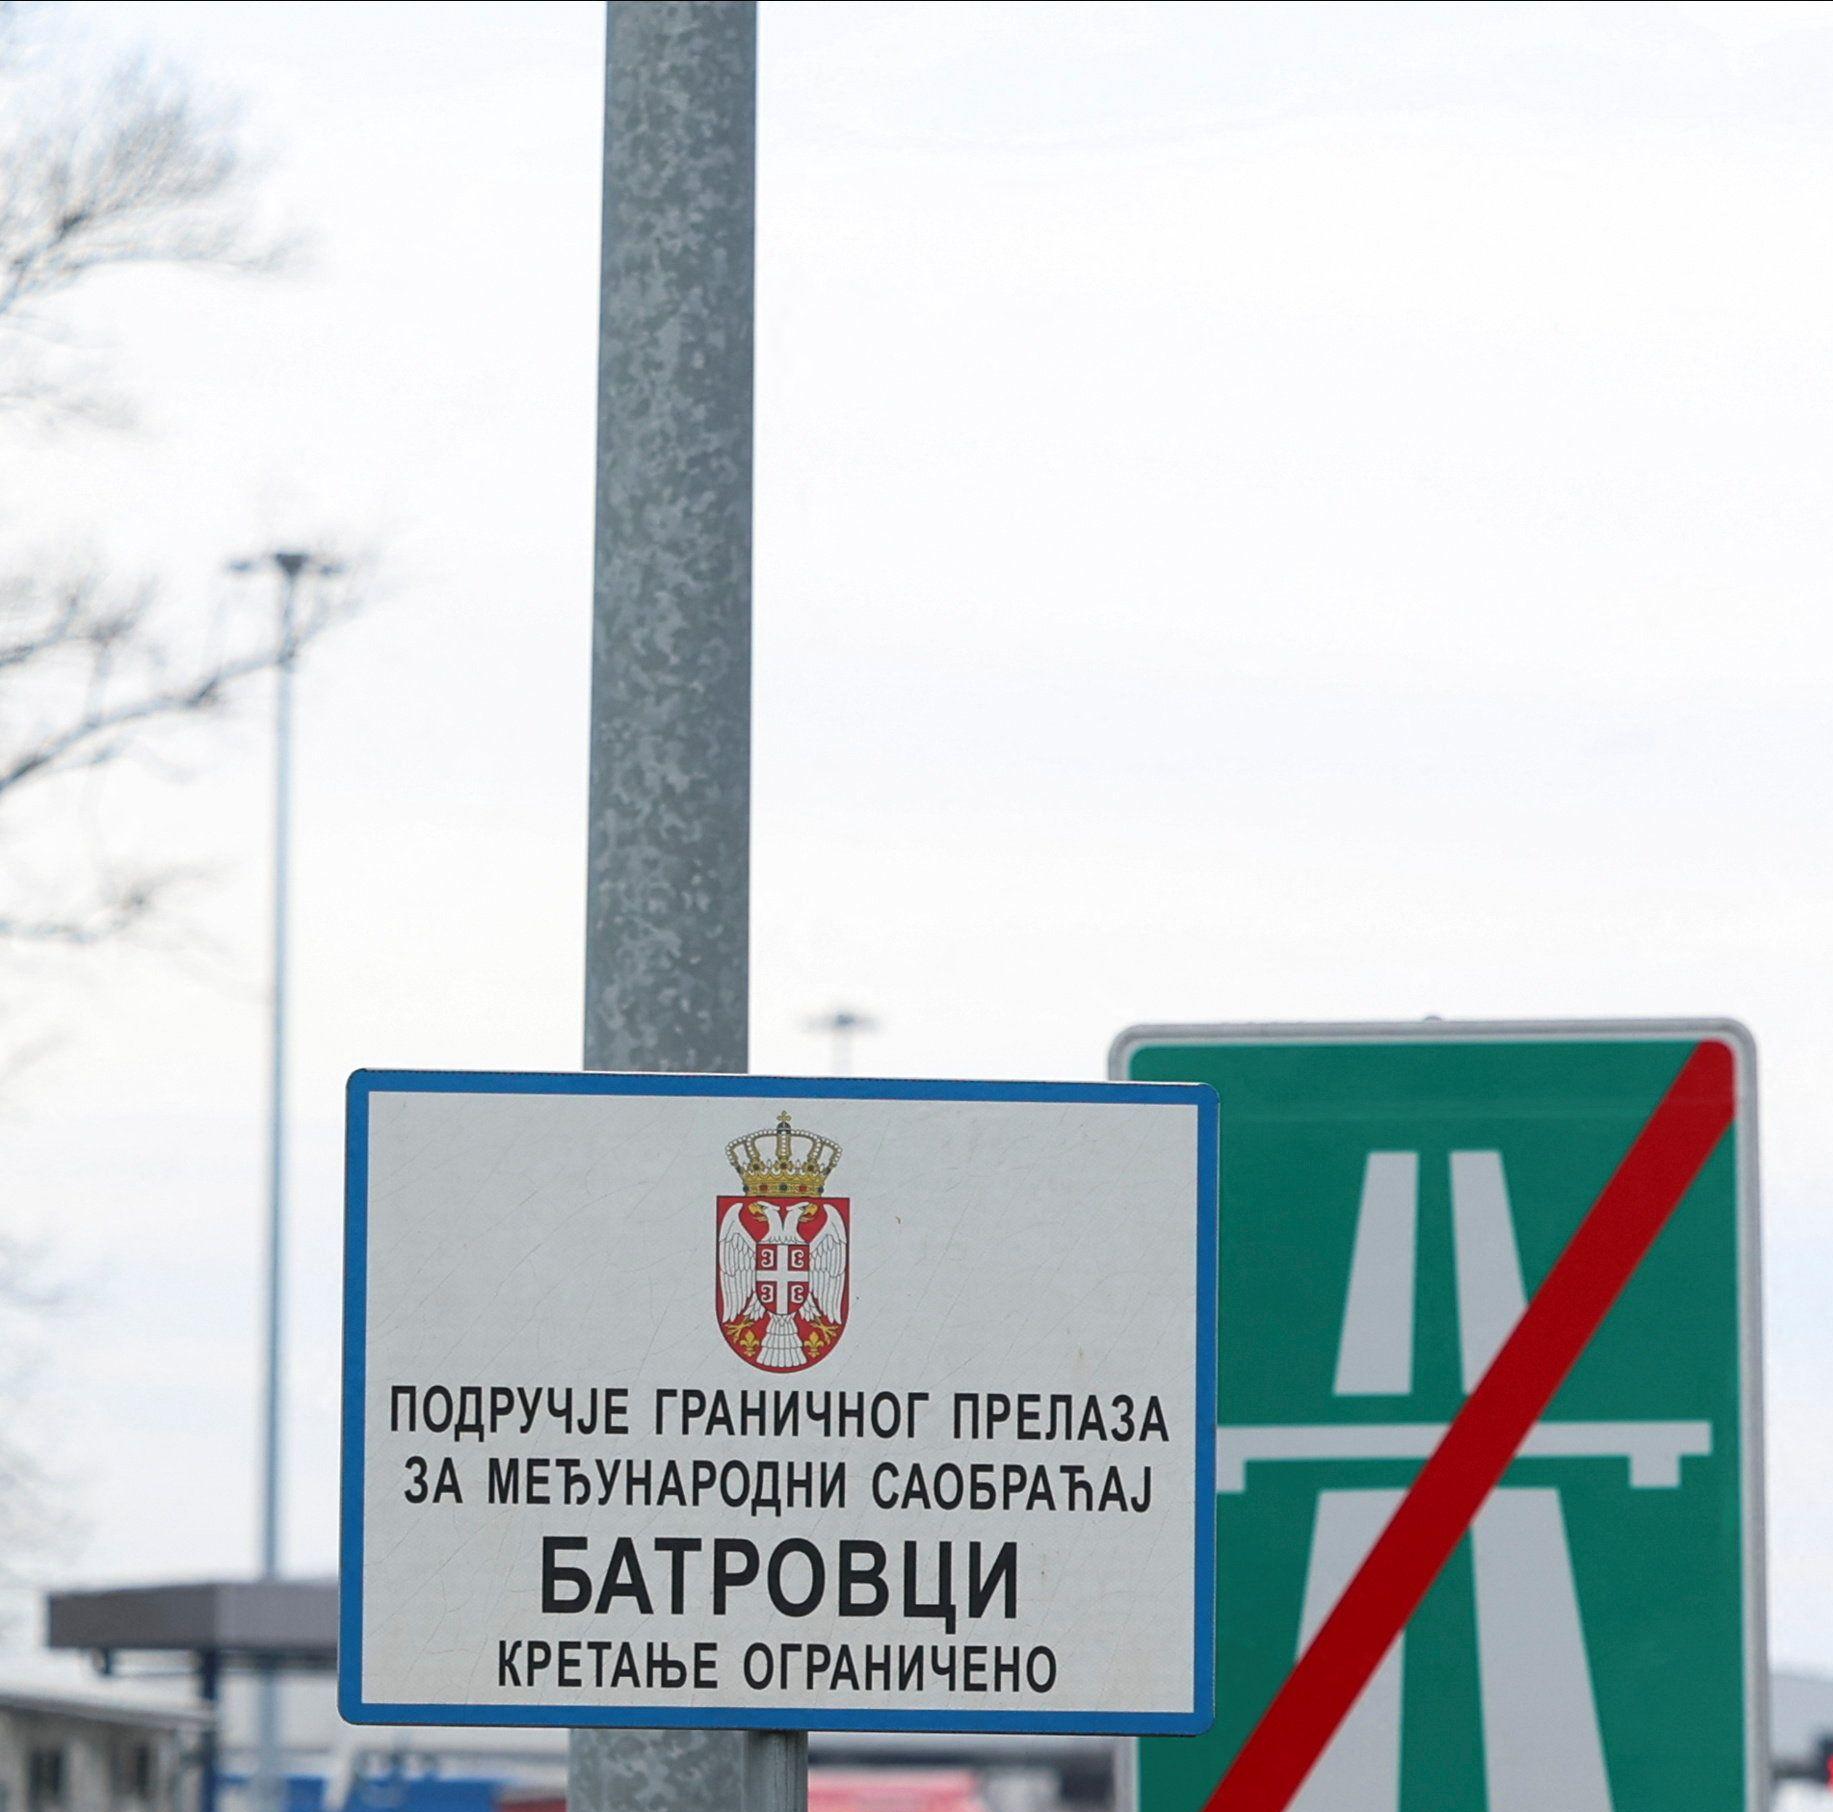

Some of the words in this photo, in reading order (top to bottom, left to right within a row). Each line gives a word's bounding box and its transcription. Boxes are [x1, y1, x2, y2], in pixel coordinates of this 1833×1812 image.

[390, 1384, 629, 1443] ПОДРУЧЈЕ
[655, 1388, 930, 1439] ГРАНИЧНОГ
[953, 1392, 1170, 1442] ПРЕЛАЗА
[404, 1455, 463, 1504] ЗА
[488, 1457, 846, 1518] МЕЂУНАРОДНИ
[872, 1461, 1151, 1513] САОБРАЋАЈ
[541, 1535, 1018, 1635] БАТРОВЦИ
[498, 1640, 718, 1689] КРЕТАЊЕ
[743, 1642, 1057, 1694] ОГРАНИЧЕНО
